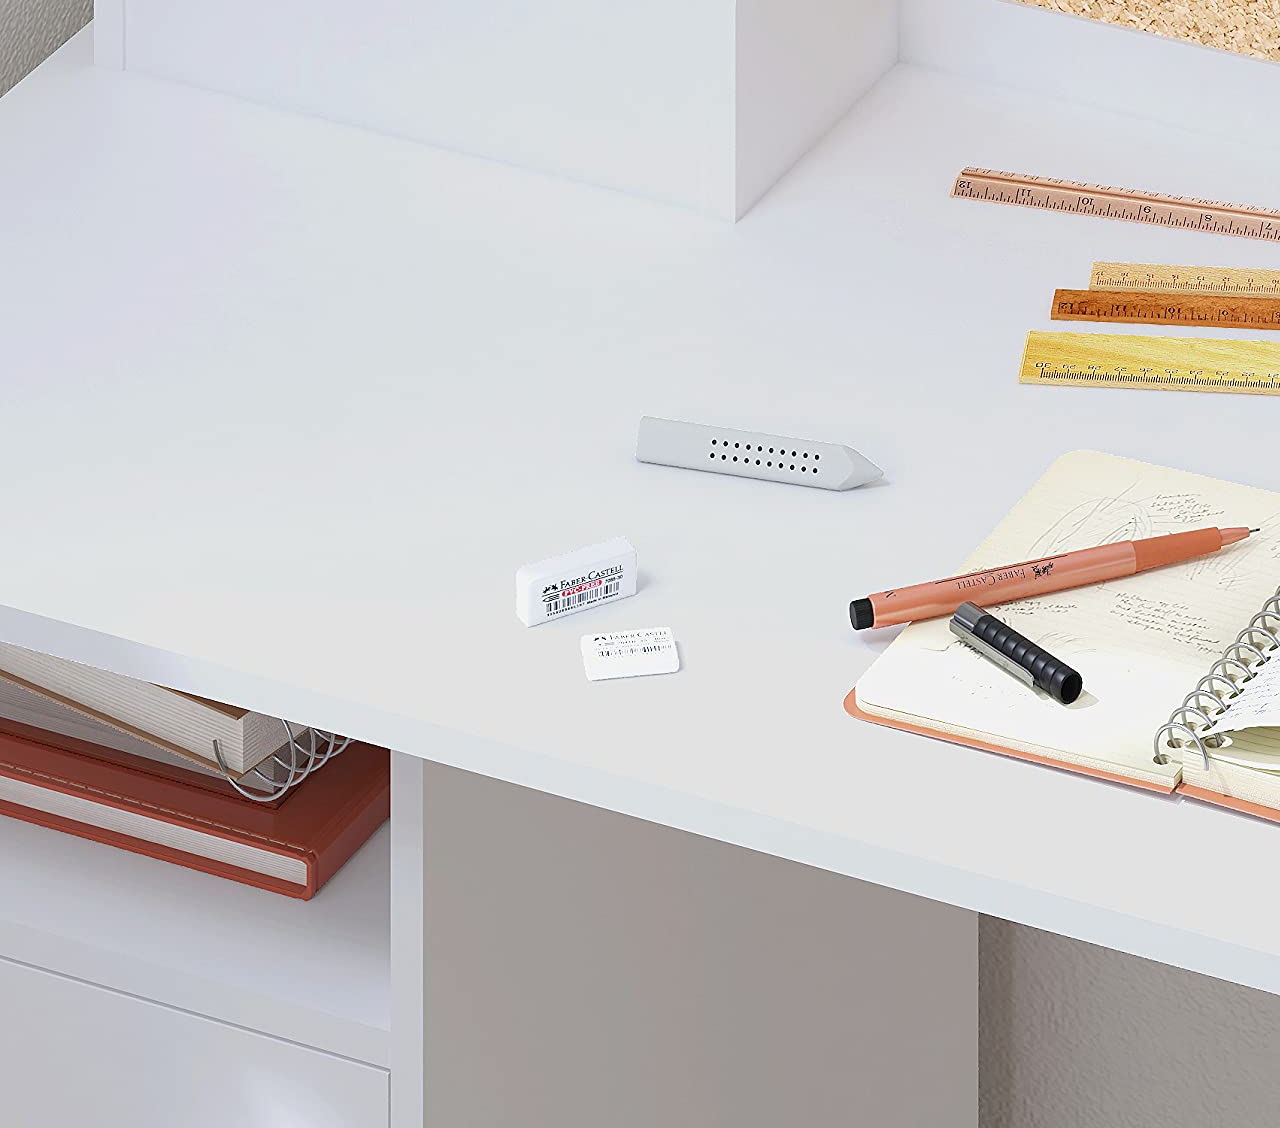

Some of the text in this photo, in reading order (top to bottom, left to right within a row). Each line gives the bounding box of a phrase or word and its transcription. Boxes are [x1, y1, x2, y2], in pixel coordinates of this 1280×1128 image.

[958, 179, 971, 189] 12
[1020, 188, 1031, 197] 11
[1081, 196, 1094, 206] 10
[1143, 204, 1151, 214] 9
[1204, 214, 1213, 222] 8
[1264, 222, 1272, 230] 7
